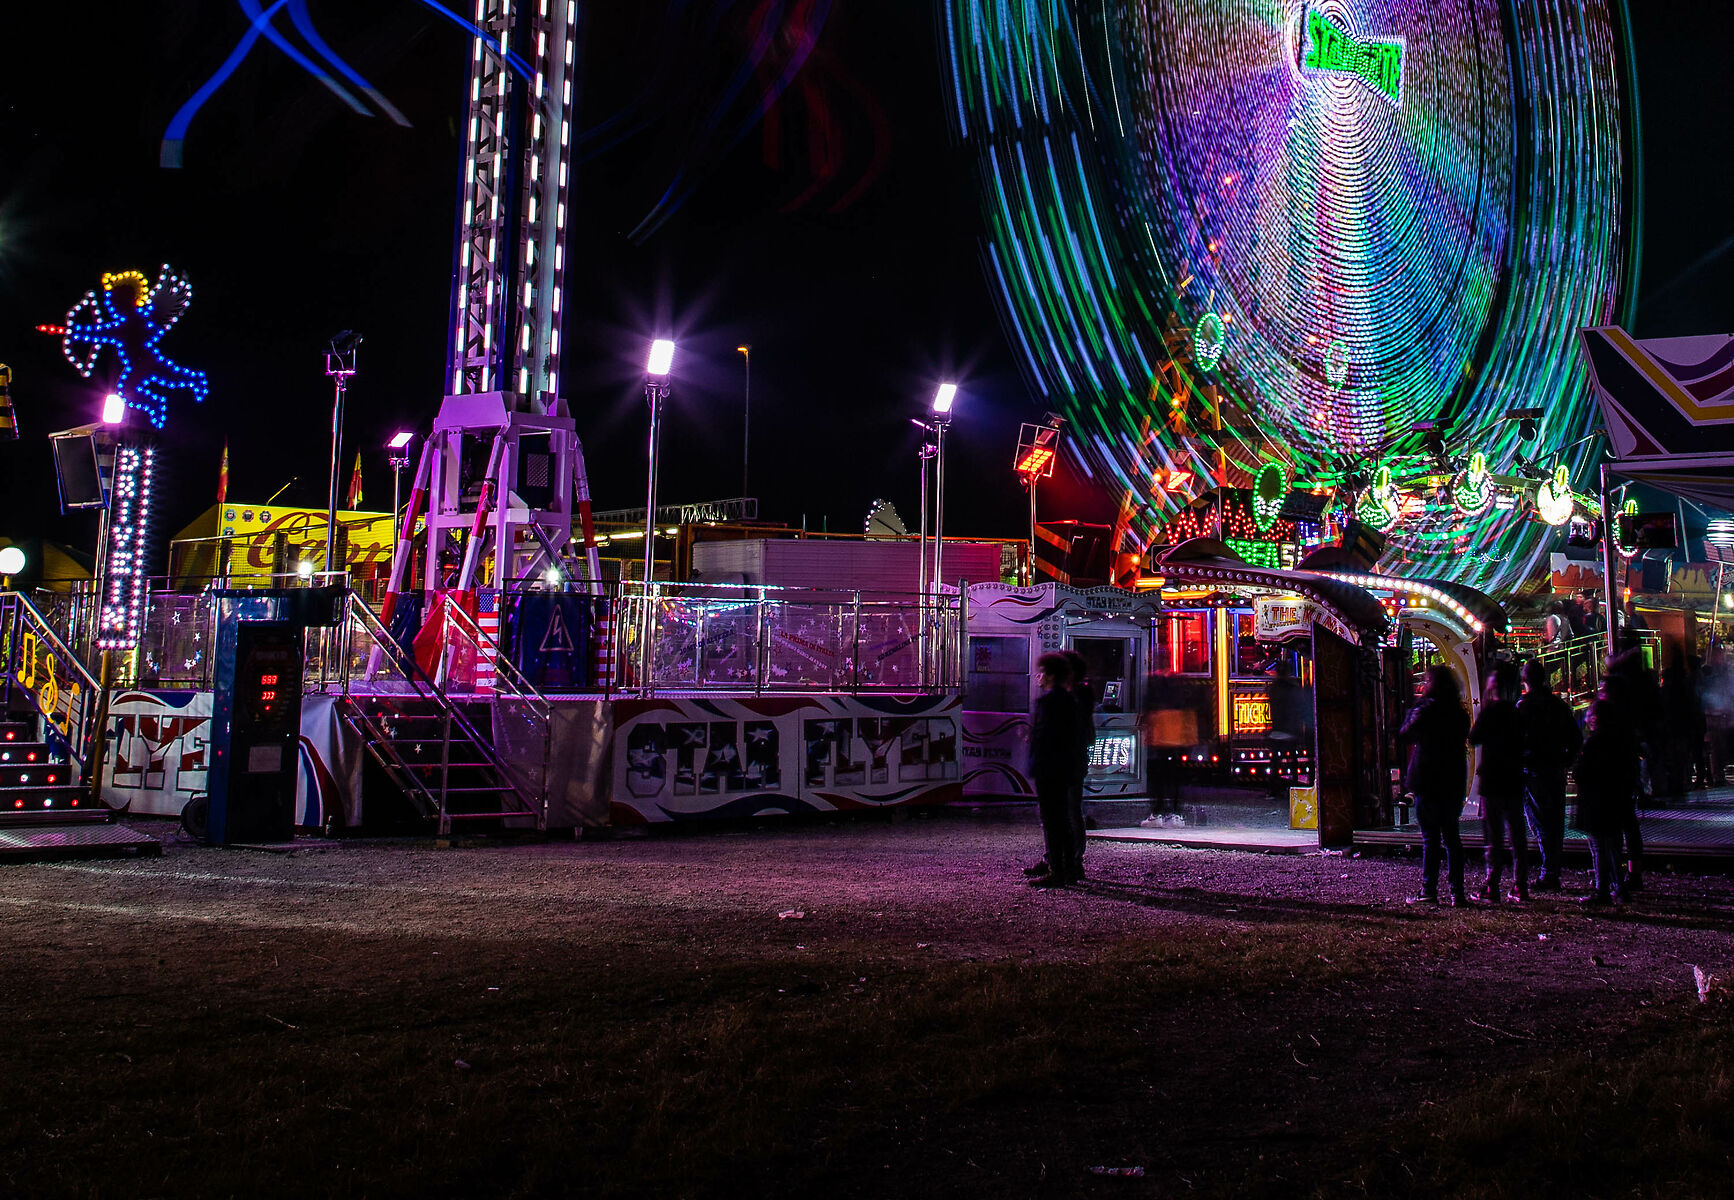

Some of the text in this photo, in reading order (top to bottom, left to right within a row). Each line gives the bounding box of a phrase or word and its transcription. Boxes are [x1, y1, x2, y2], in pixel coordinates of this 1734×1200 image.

[1271, 606, 1297, 622] THE
[626, 716, 958, 798] STAR FLYER
